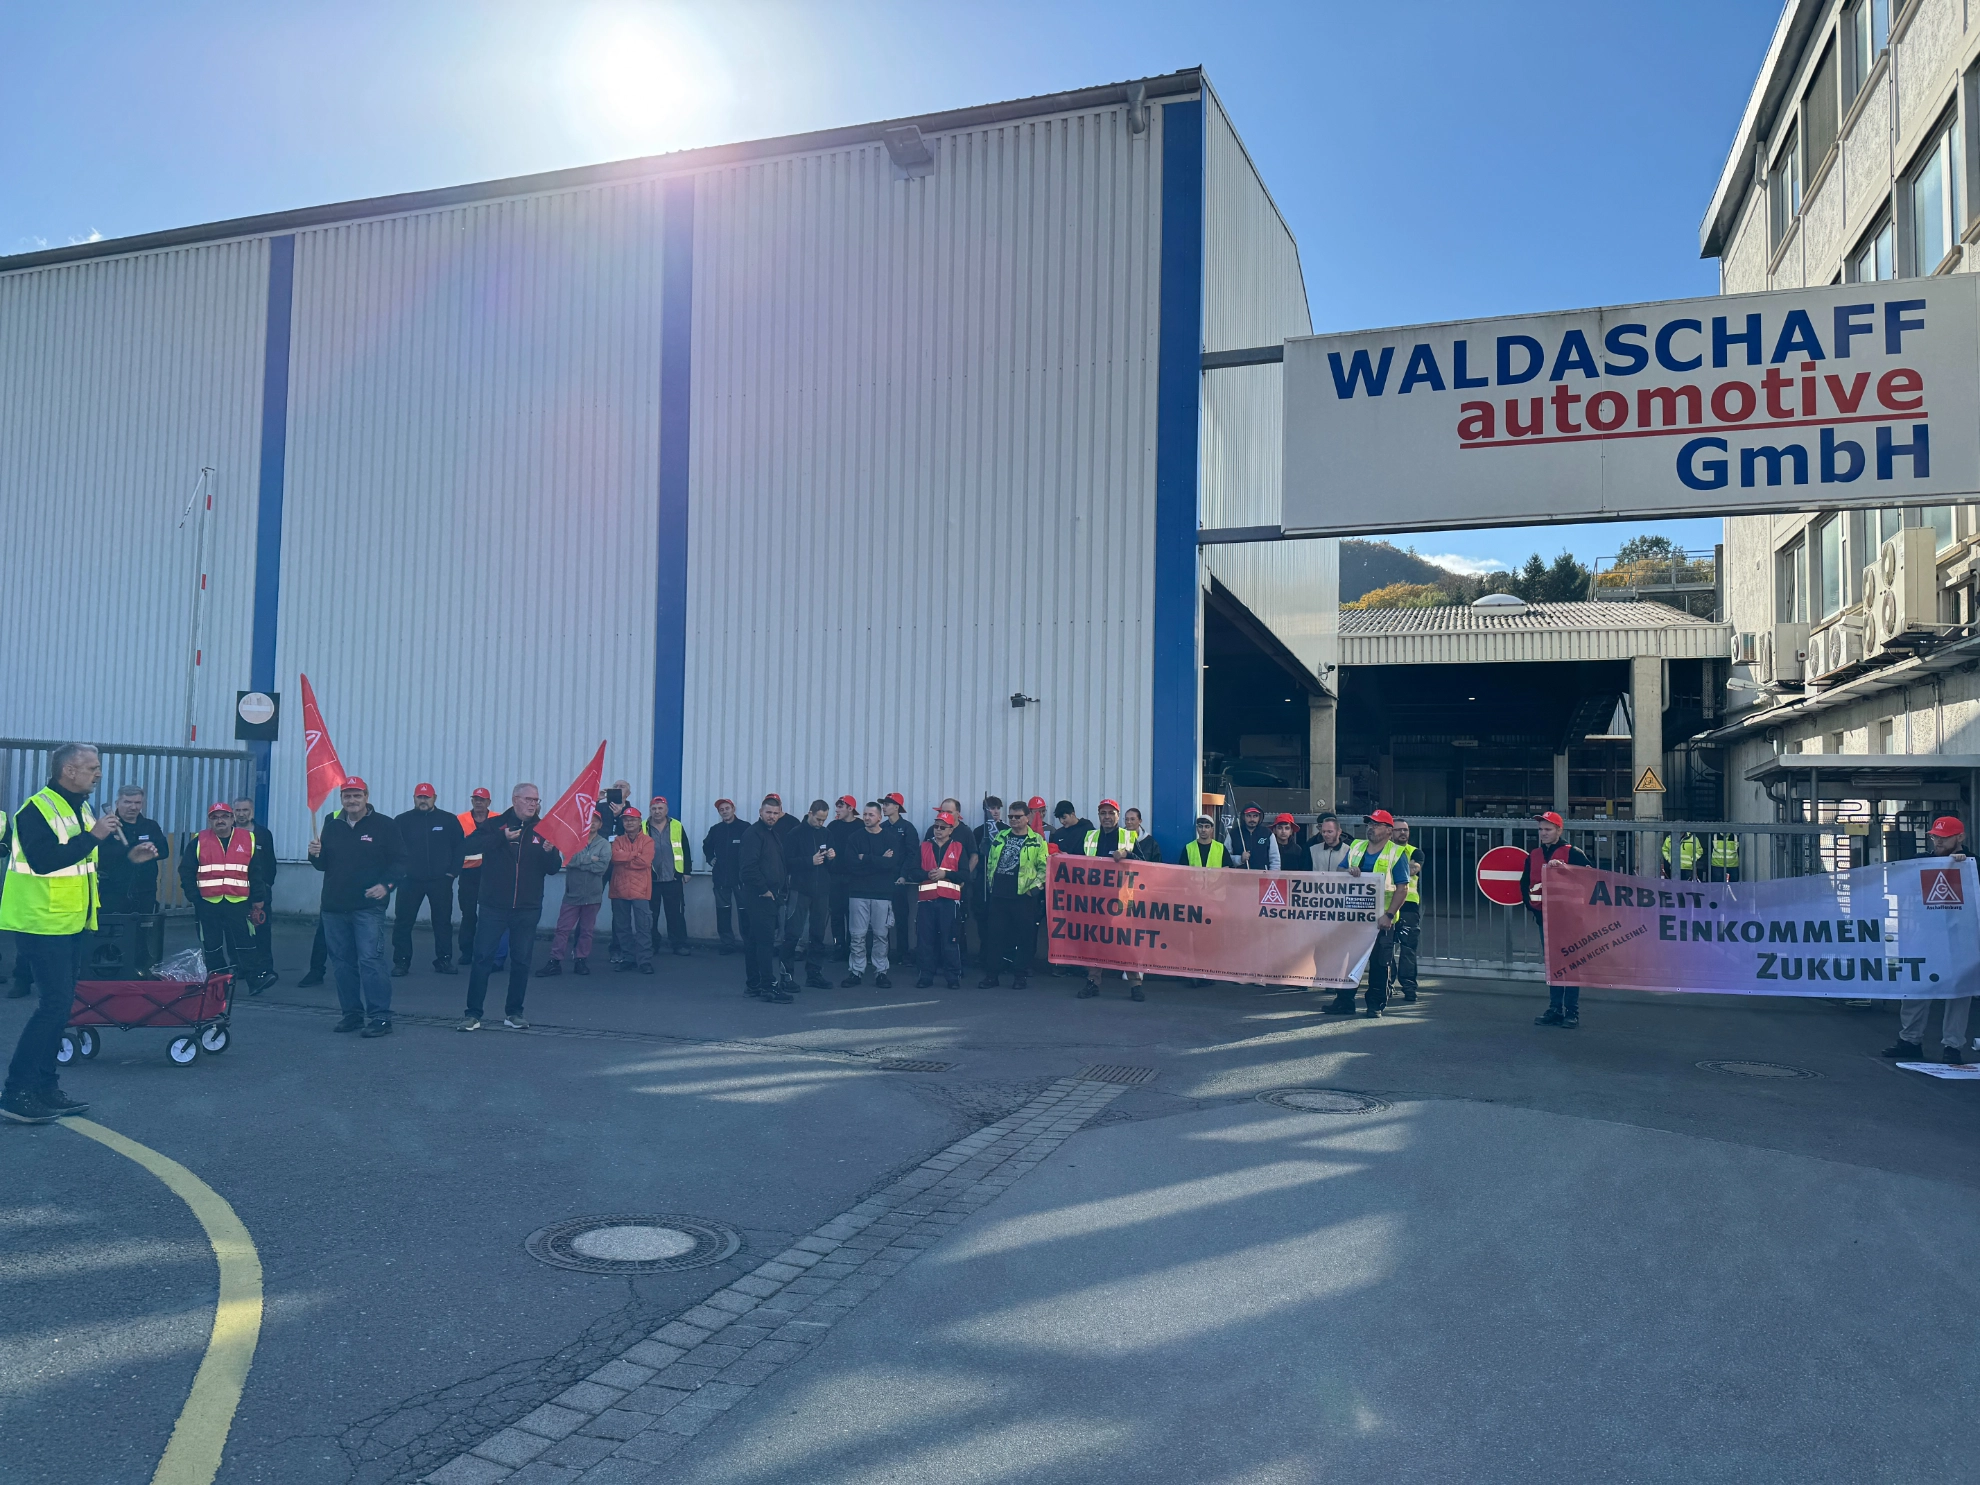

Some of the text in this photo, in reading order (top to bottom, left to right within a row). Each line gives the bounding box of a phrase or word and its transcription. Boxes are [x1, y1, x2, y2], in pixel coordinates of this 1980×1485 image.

[1327, 299, 1927, 399] WALDASCHAFF
[1457, 360, 1925, 442] automotive
[1676, 424, 1930, 491] GmbH
[1054, 861, 1146, 890] ARBEIT.
[1291, 879, 1377, 896] ZUKUNFTS
[1052, 889, 1212, 925] EINKOMMEN.
[1291, 894, 1345, 909] REGION
[1588, 880, 1718, 909] ARBEIT.
[1258, 906, 1376, 922] ASCHAFFENBURG
[1051, 917, 1168, 950] ZUKUNFT.
[1560, 920, 1622, 957] SOLIDARISCH
[1553, 924, 1648, 979] IST MAN NICHT ALLEINE!
[1756, 952, 1940, 982] ZUKUNFT.
